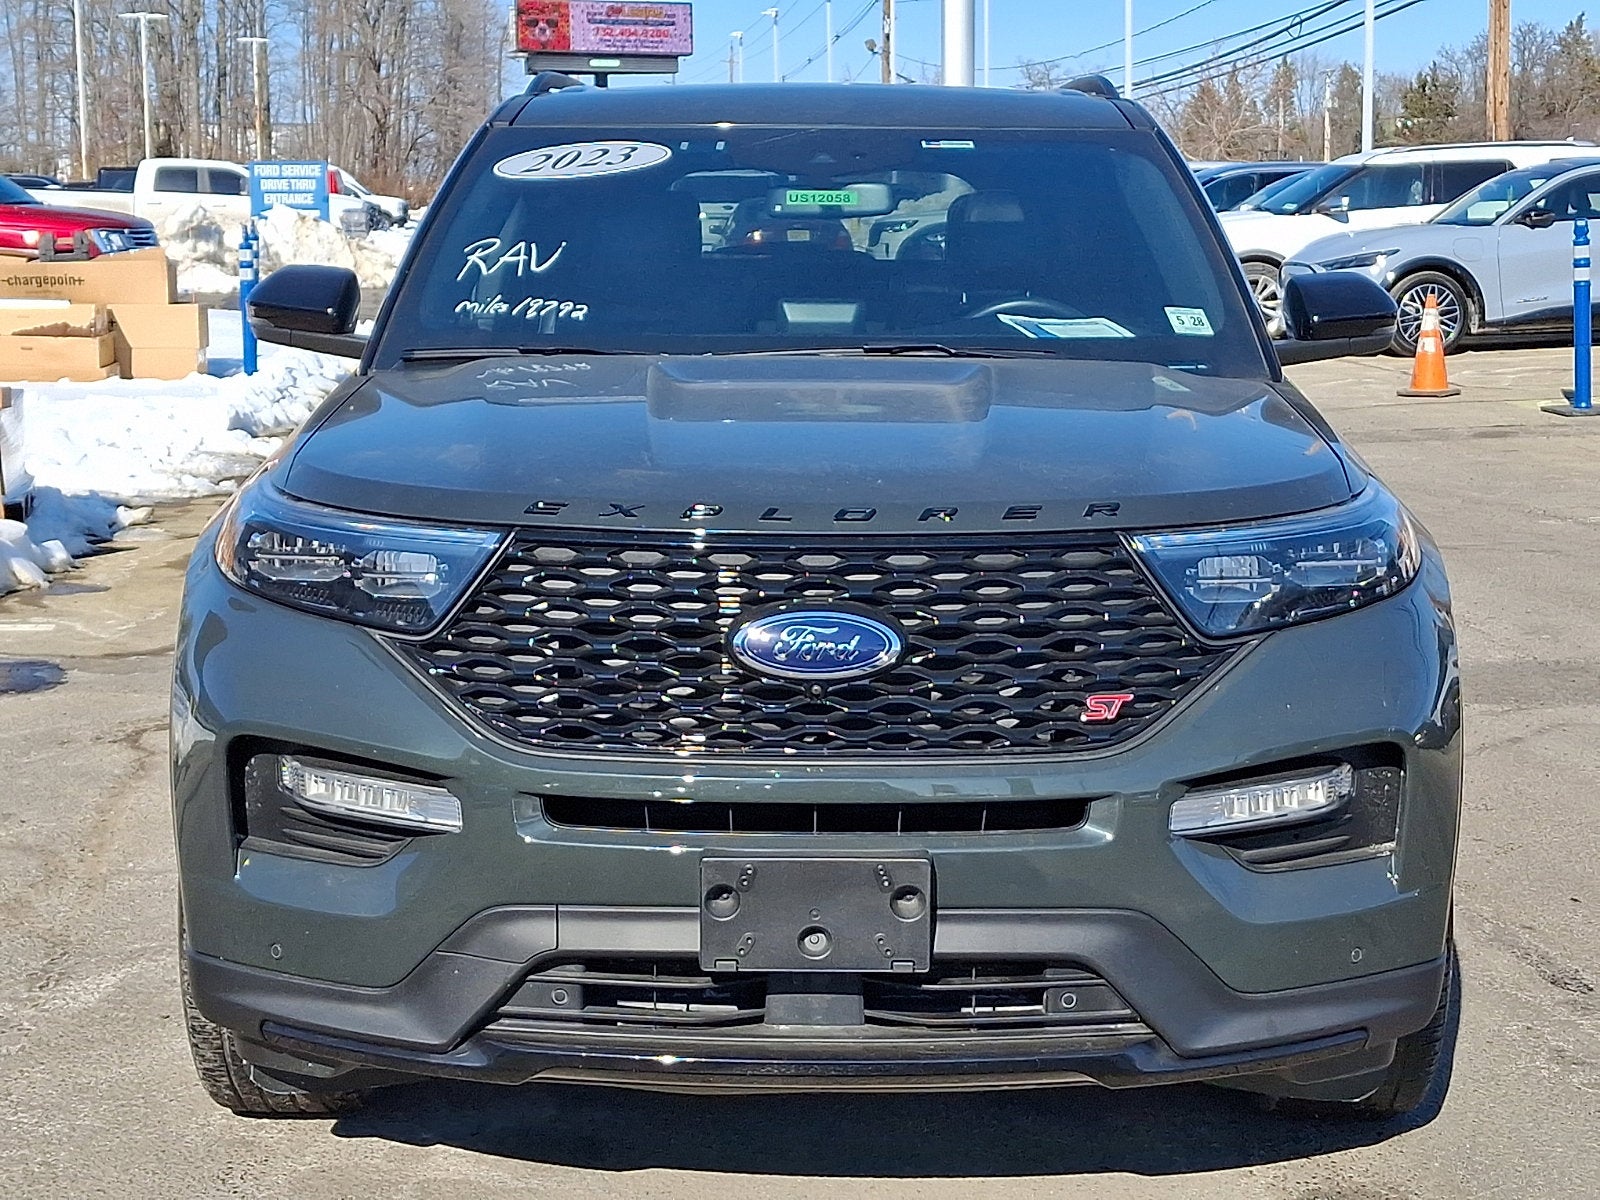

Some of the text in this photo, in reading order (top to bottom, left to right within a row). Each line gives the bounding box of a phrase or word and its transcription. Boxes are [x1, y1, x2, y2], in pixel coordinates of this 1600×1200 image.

[519, 146, 639, 173] 2023
[254, 164, 322, 177] FORD SERVICE
[260, 179, 316, 190] DRIVE THRU
[263, 192, 315, 205] ENTRANCE
[789, 193, 851, 203] US12058
[456, 237, 567, 282] RAV
[1176, 315, 1205, 327] 5 28
[523, 500, 1121, 522] EXPLORER
[773, 625, 861, 662] Ford
[1080, 693, 1135, 722] ST
